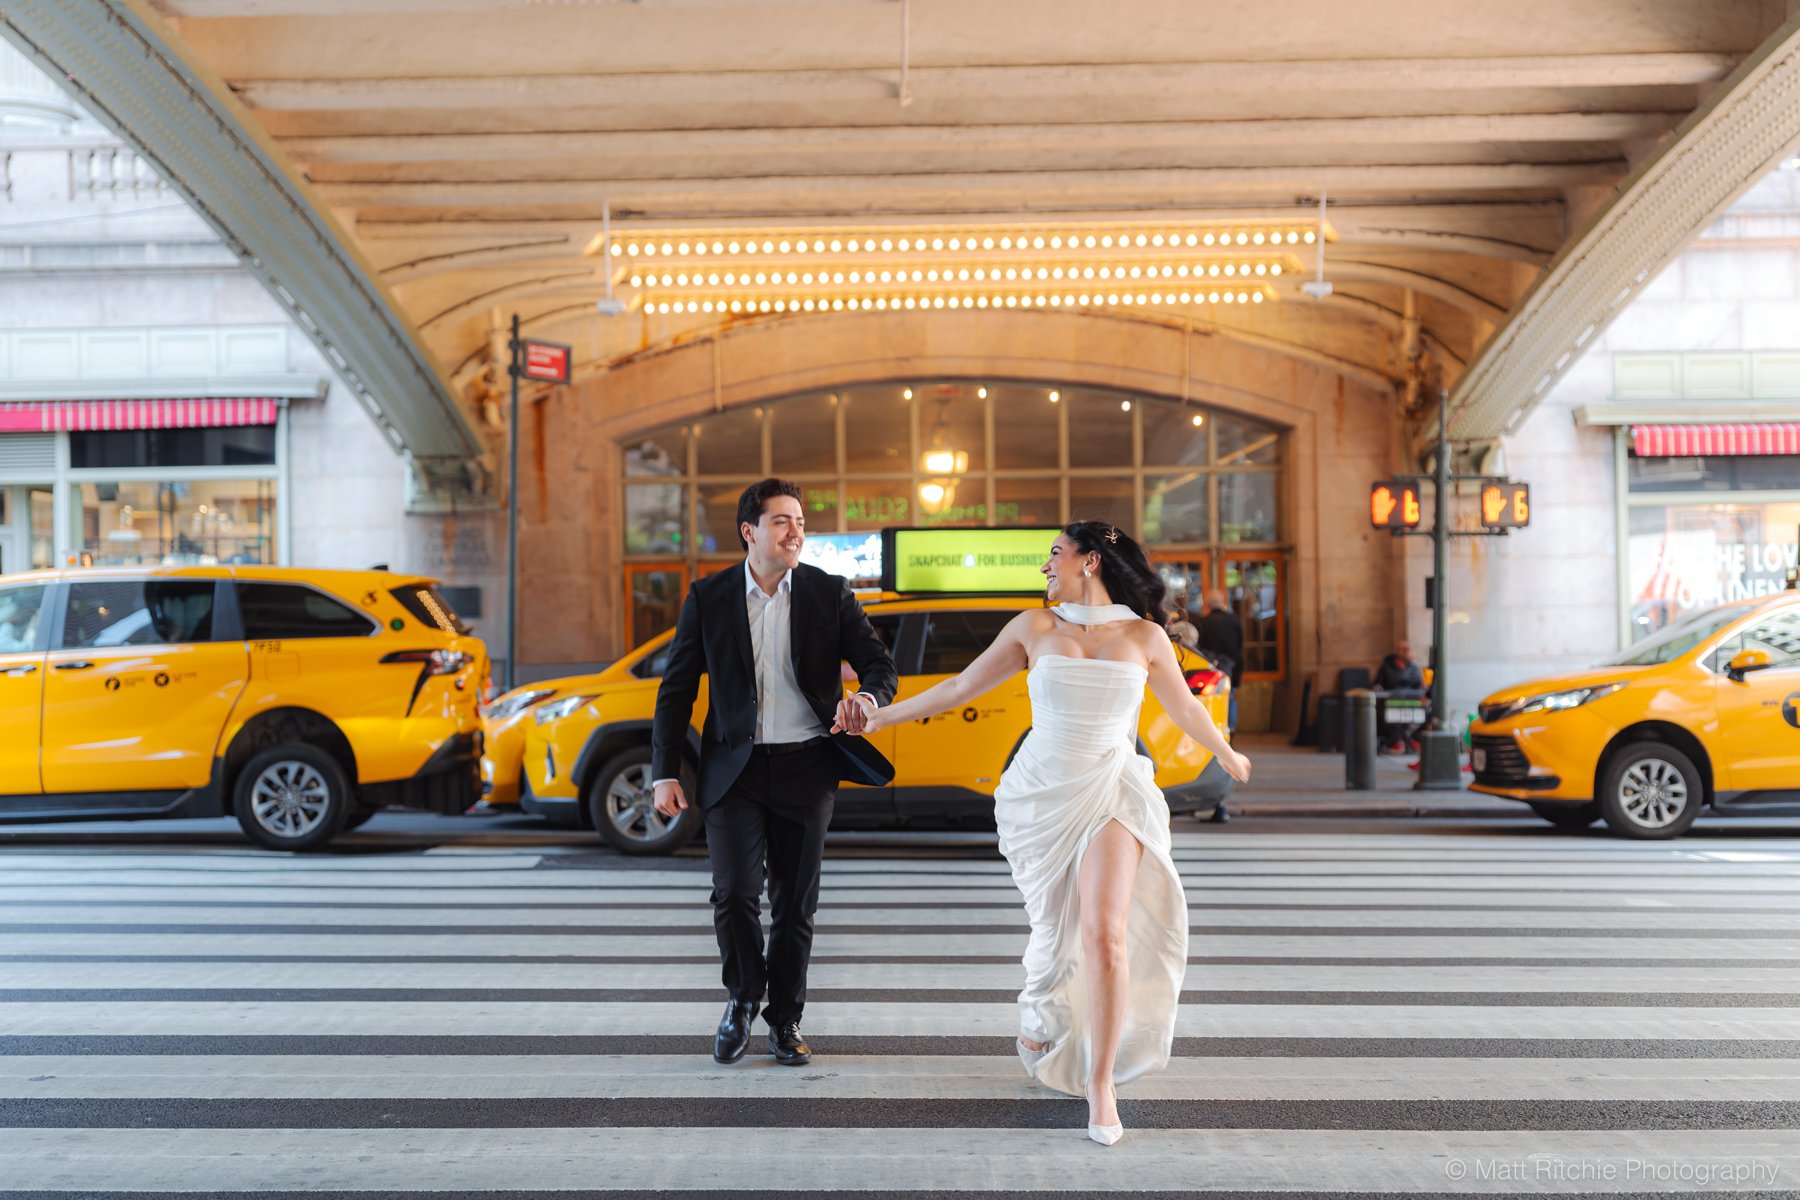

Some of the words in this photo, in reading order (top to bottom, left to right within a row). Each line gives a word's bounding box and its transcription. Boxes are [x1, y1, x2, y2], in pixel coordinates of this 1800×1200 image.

[1513, 490, 1529, 522] 6
[908, 553, 962, 567] SNAPCHAT
[977, 553, 998, 567] FOR
